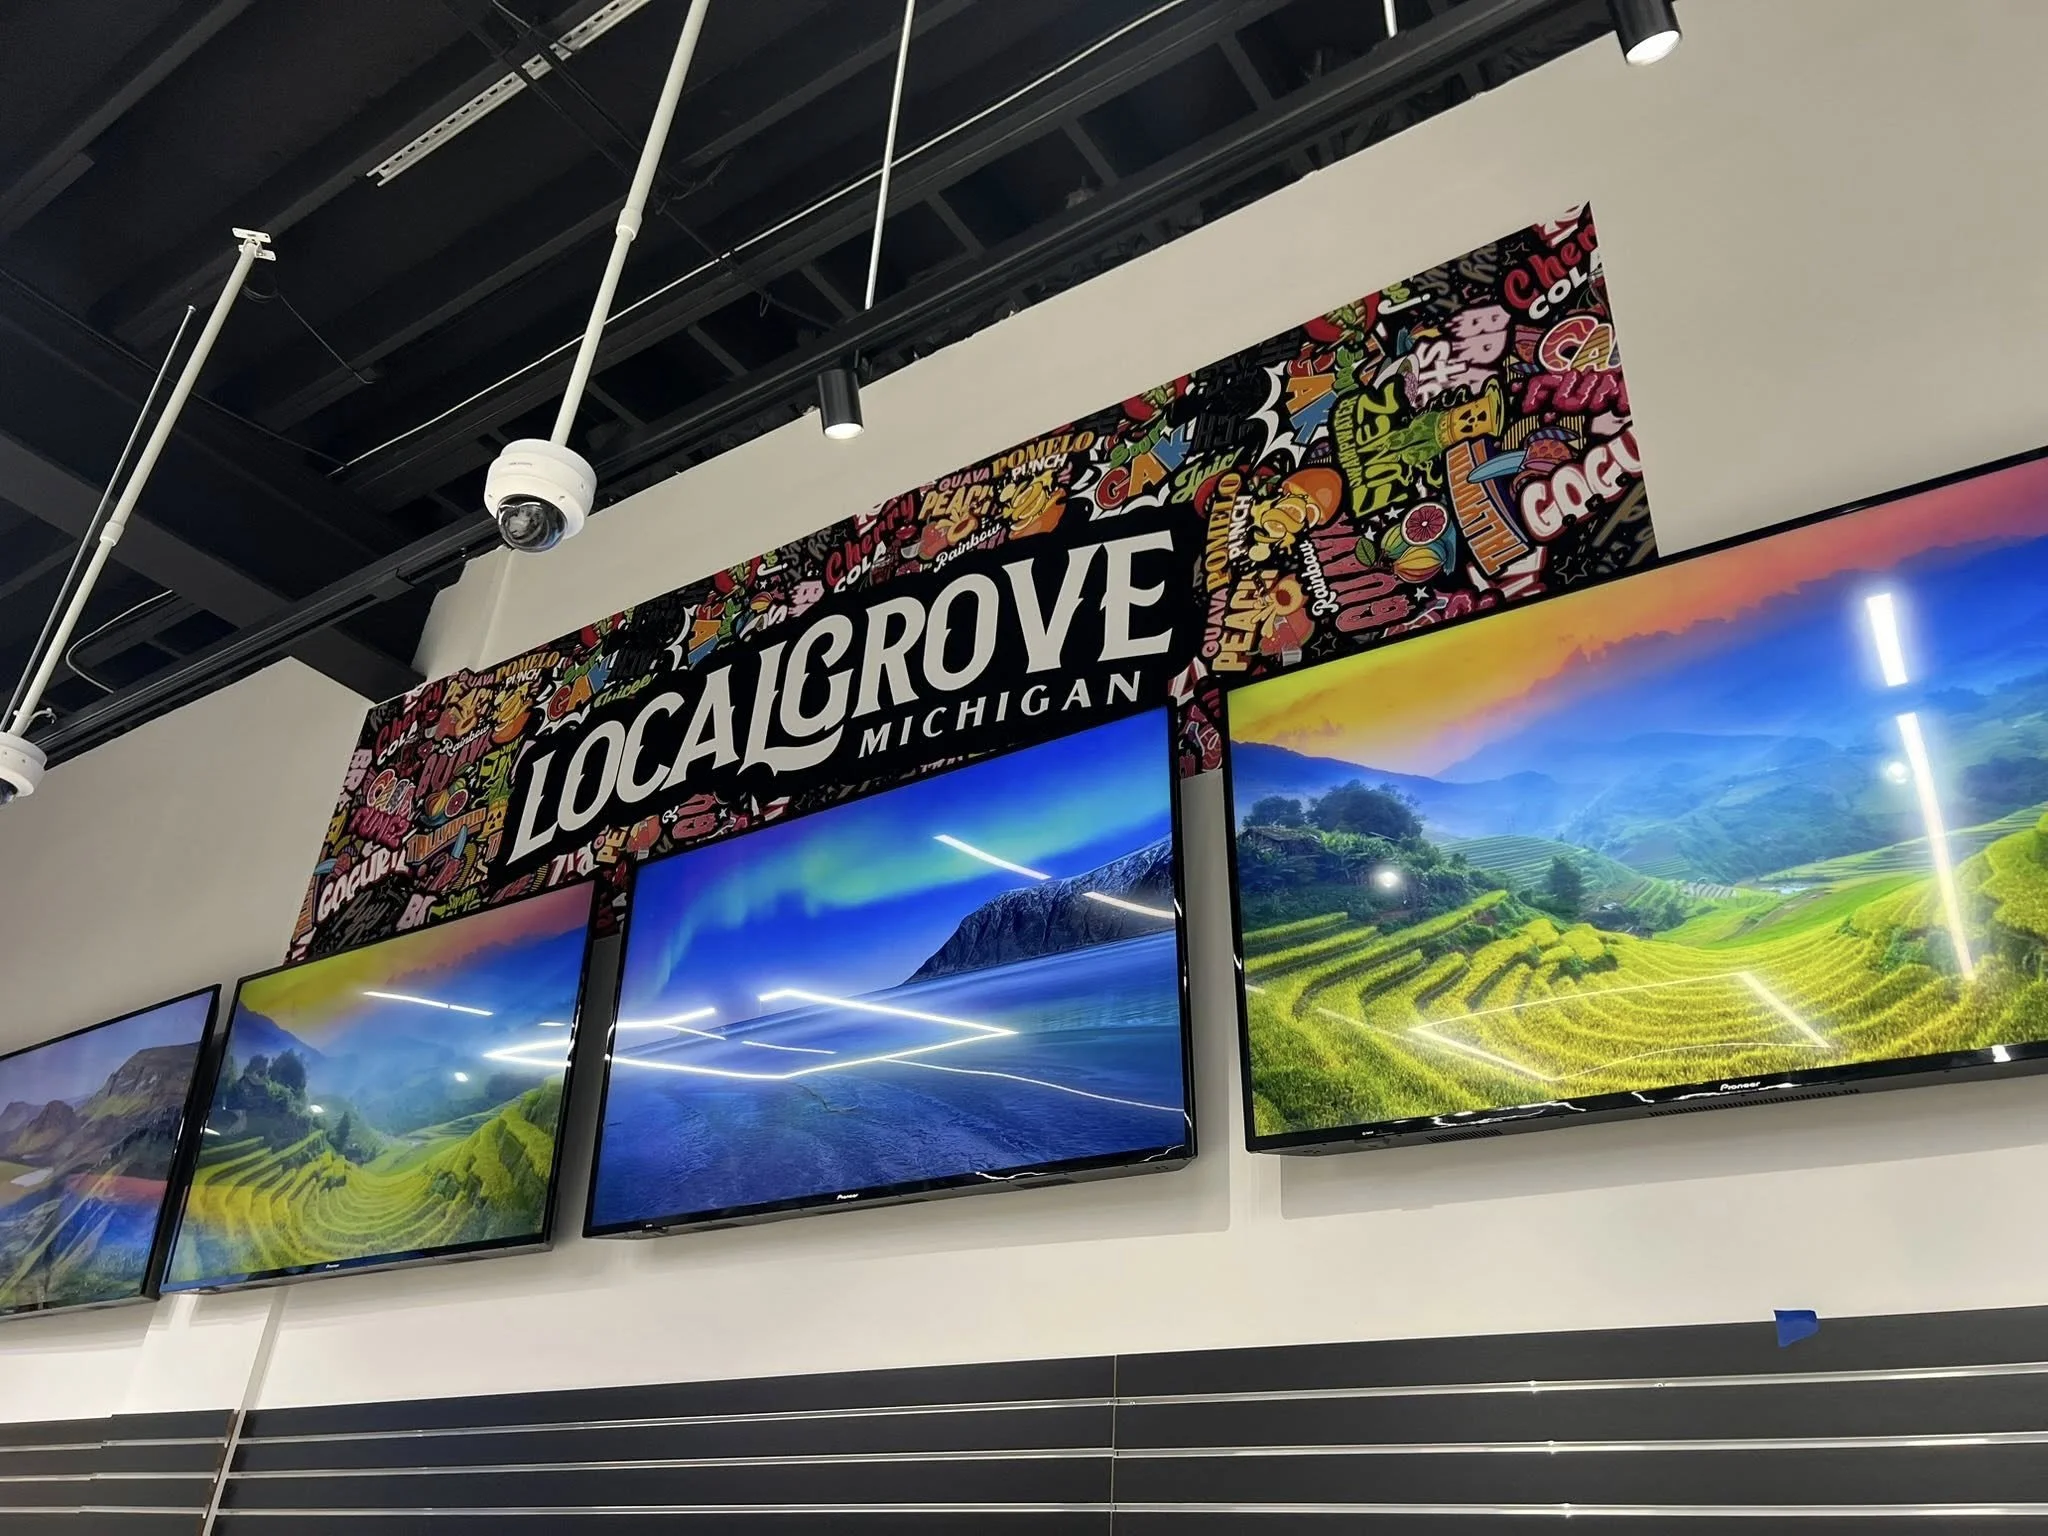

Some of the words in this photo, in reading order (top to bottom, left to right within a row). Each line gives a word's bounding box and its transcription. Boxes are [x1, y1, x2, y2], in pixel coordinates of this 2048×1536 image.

[939, 467, 990, 491] GUAVA
[992, 430, 1095, 478] POMELO
[1096, 423, 1194, 510] GAK
[825, 494, 914, 587] Cherry
[934, 523, 1002, 573] Rainbow
[1205, 472, 1241, 592] POMELO
[834, 540, 888, 593] COLA
[1300, 539, 1339, 616] Rainbow
[1201, 587, 1228, 658] GUAVA
[495, 650, 560, 681] POMELO
[547, 654, 611, 720] GAK
[860, 671, 1141, 760] MICHIGAN
[1720, 1081, 1761, 1091] Pioneer
